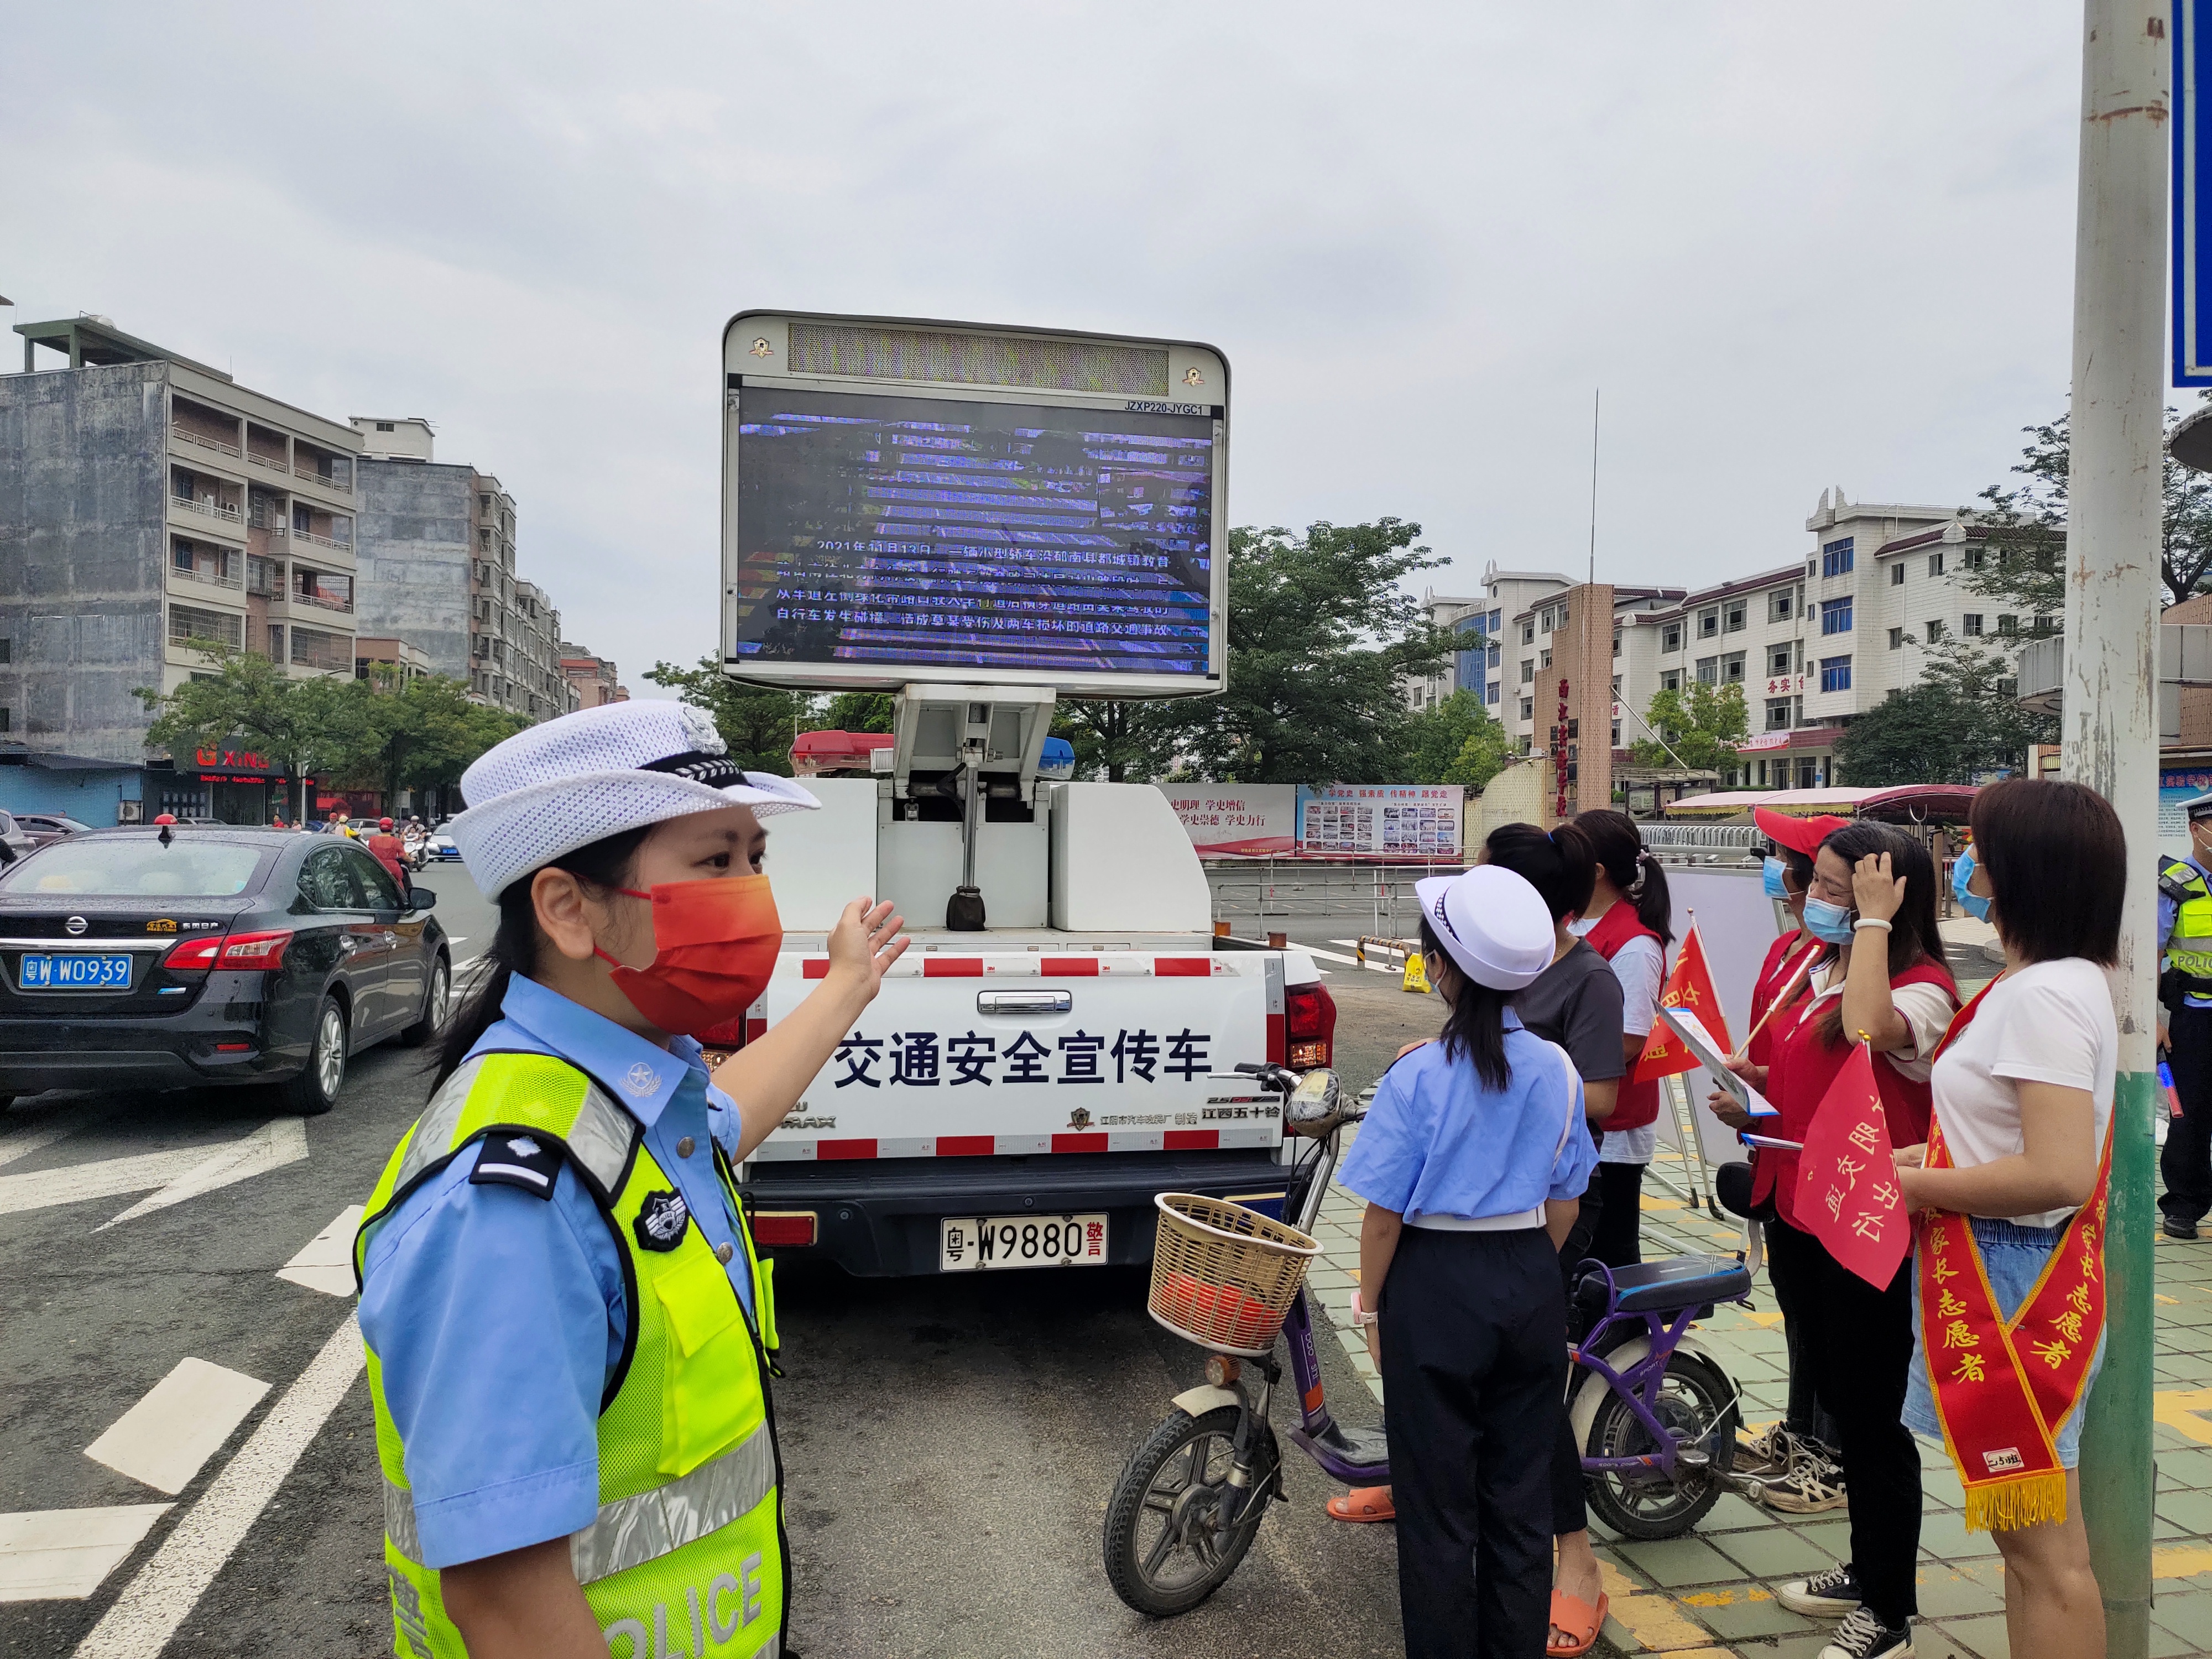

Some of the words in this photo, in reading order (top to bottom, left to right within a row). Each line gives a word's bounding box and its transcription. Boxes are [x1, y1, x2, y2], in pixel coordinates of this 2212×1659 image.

[1125, 401, 1202, 415] JZXP220-JYGC1
[1328, 789, 1354, 798] 学党史
[1171, 800, 1200, 811] 史明理
[1205, 799, 1246, 811] 学史增信
[1179, 814, 1220, 826] 学史崇德
[1225, 815, 1266, 826] 学史力行
[834, 1028, 1212, 1089] 交通安全宣传车
[1202, 1107, 1280, 1119] 江西五十铃
[781, 1115, 837, 1129] MAX
[603, 1551, 761, 1659] OLICE
